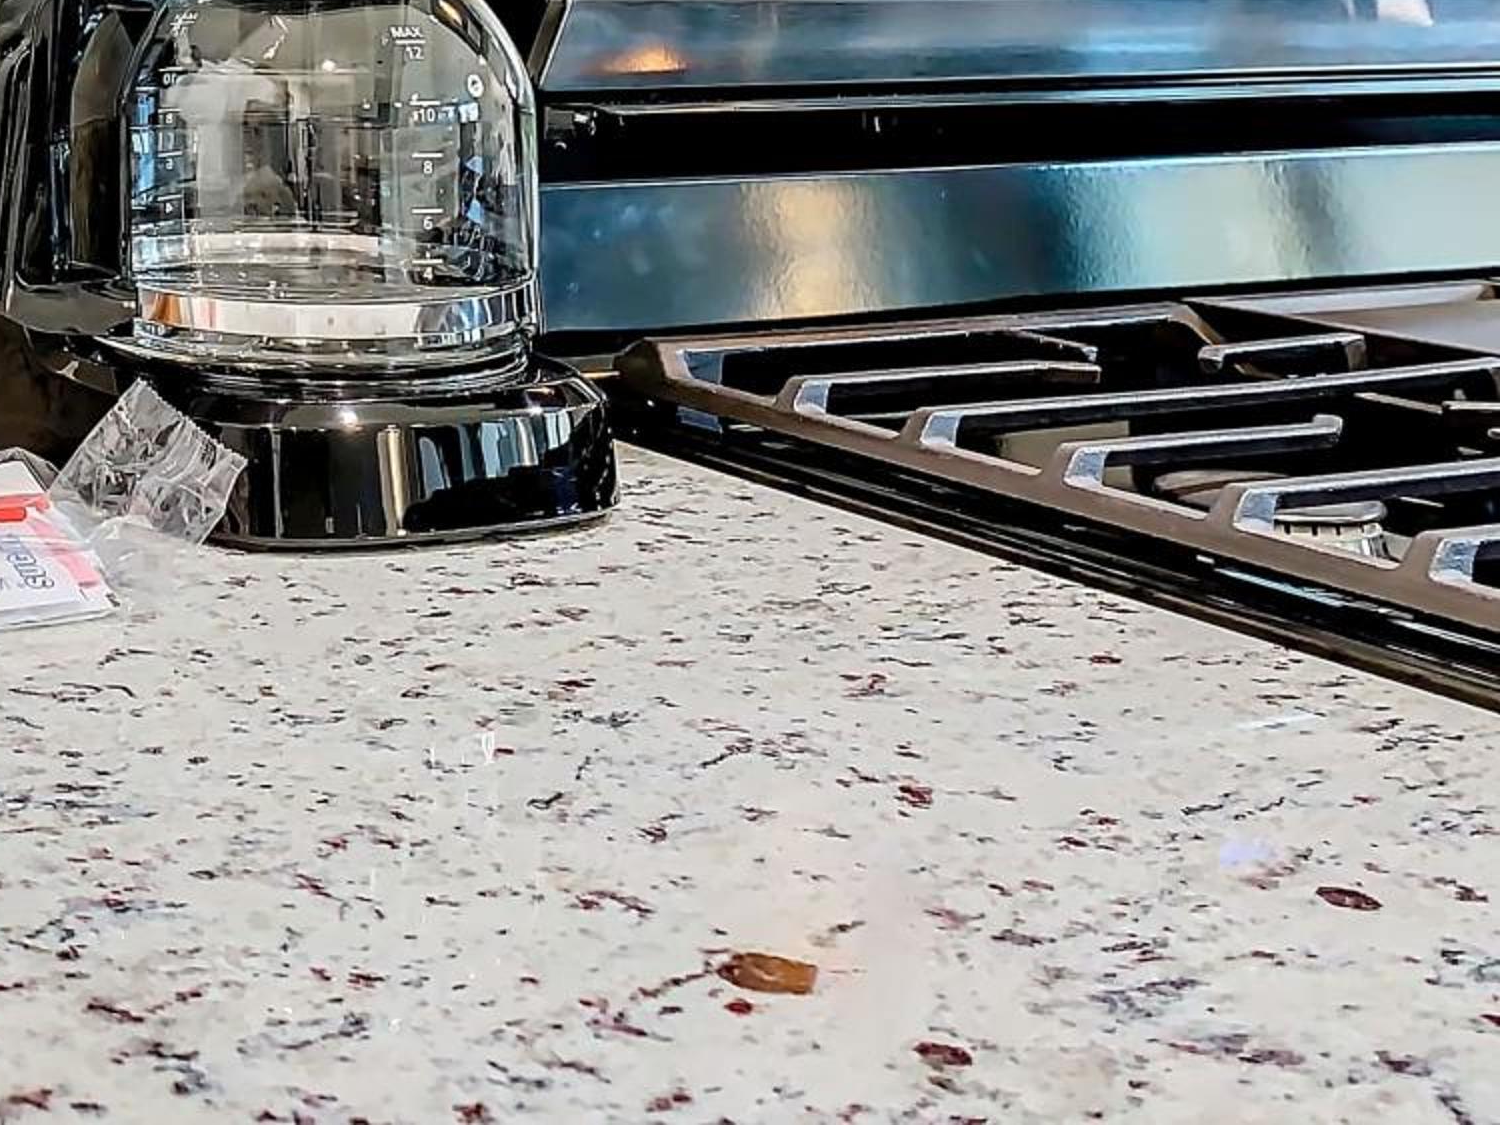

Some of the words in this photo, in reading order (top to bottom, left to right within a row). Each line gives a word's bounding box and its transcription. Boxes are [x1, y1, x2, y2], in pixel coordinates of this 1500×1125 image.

[389, 26, 423, 38] MAX
[405, 46, 425, 60] 12
[423, 159, 433, 174] 8
[423, 216, 433, 230] 6
